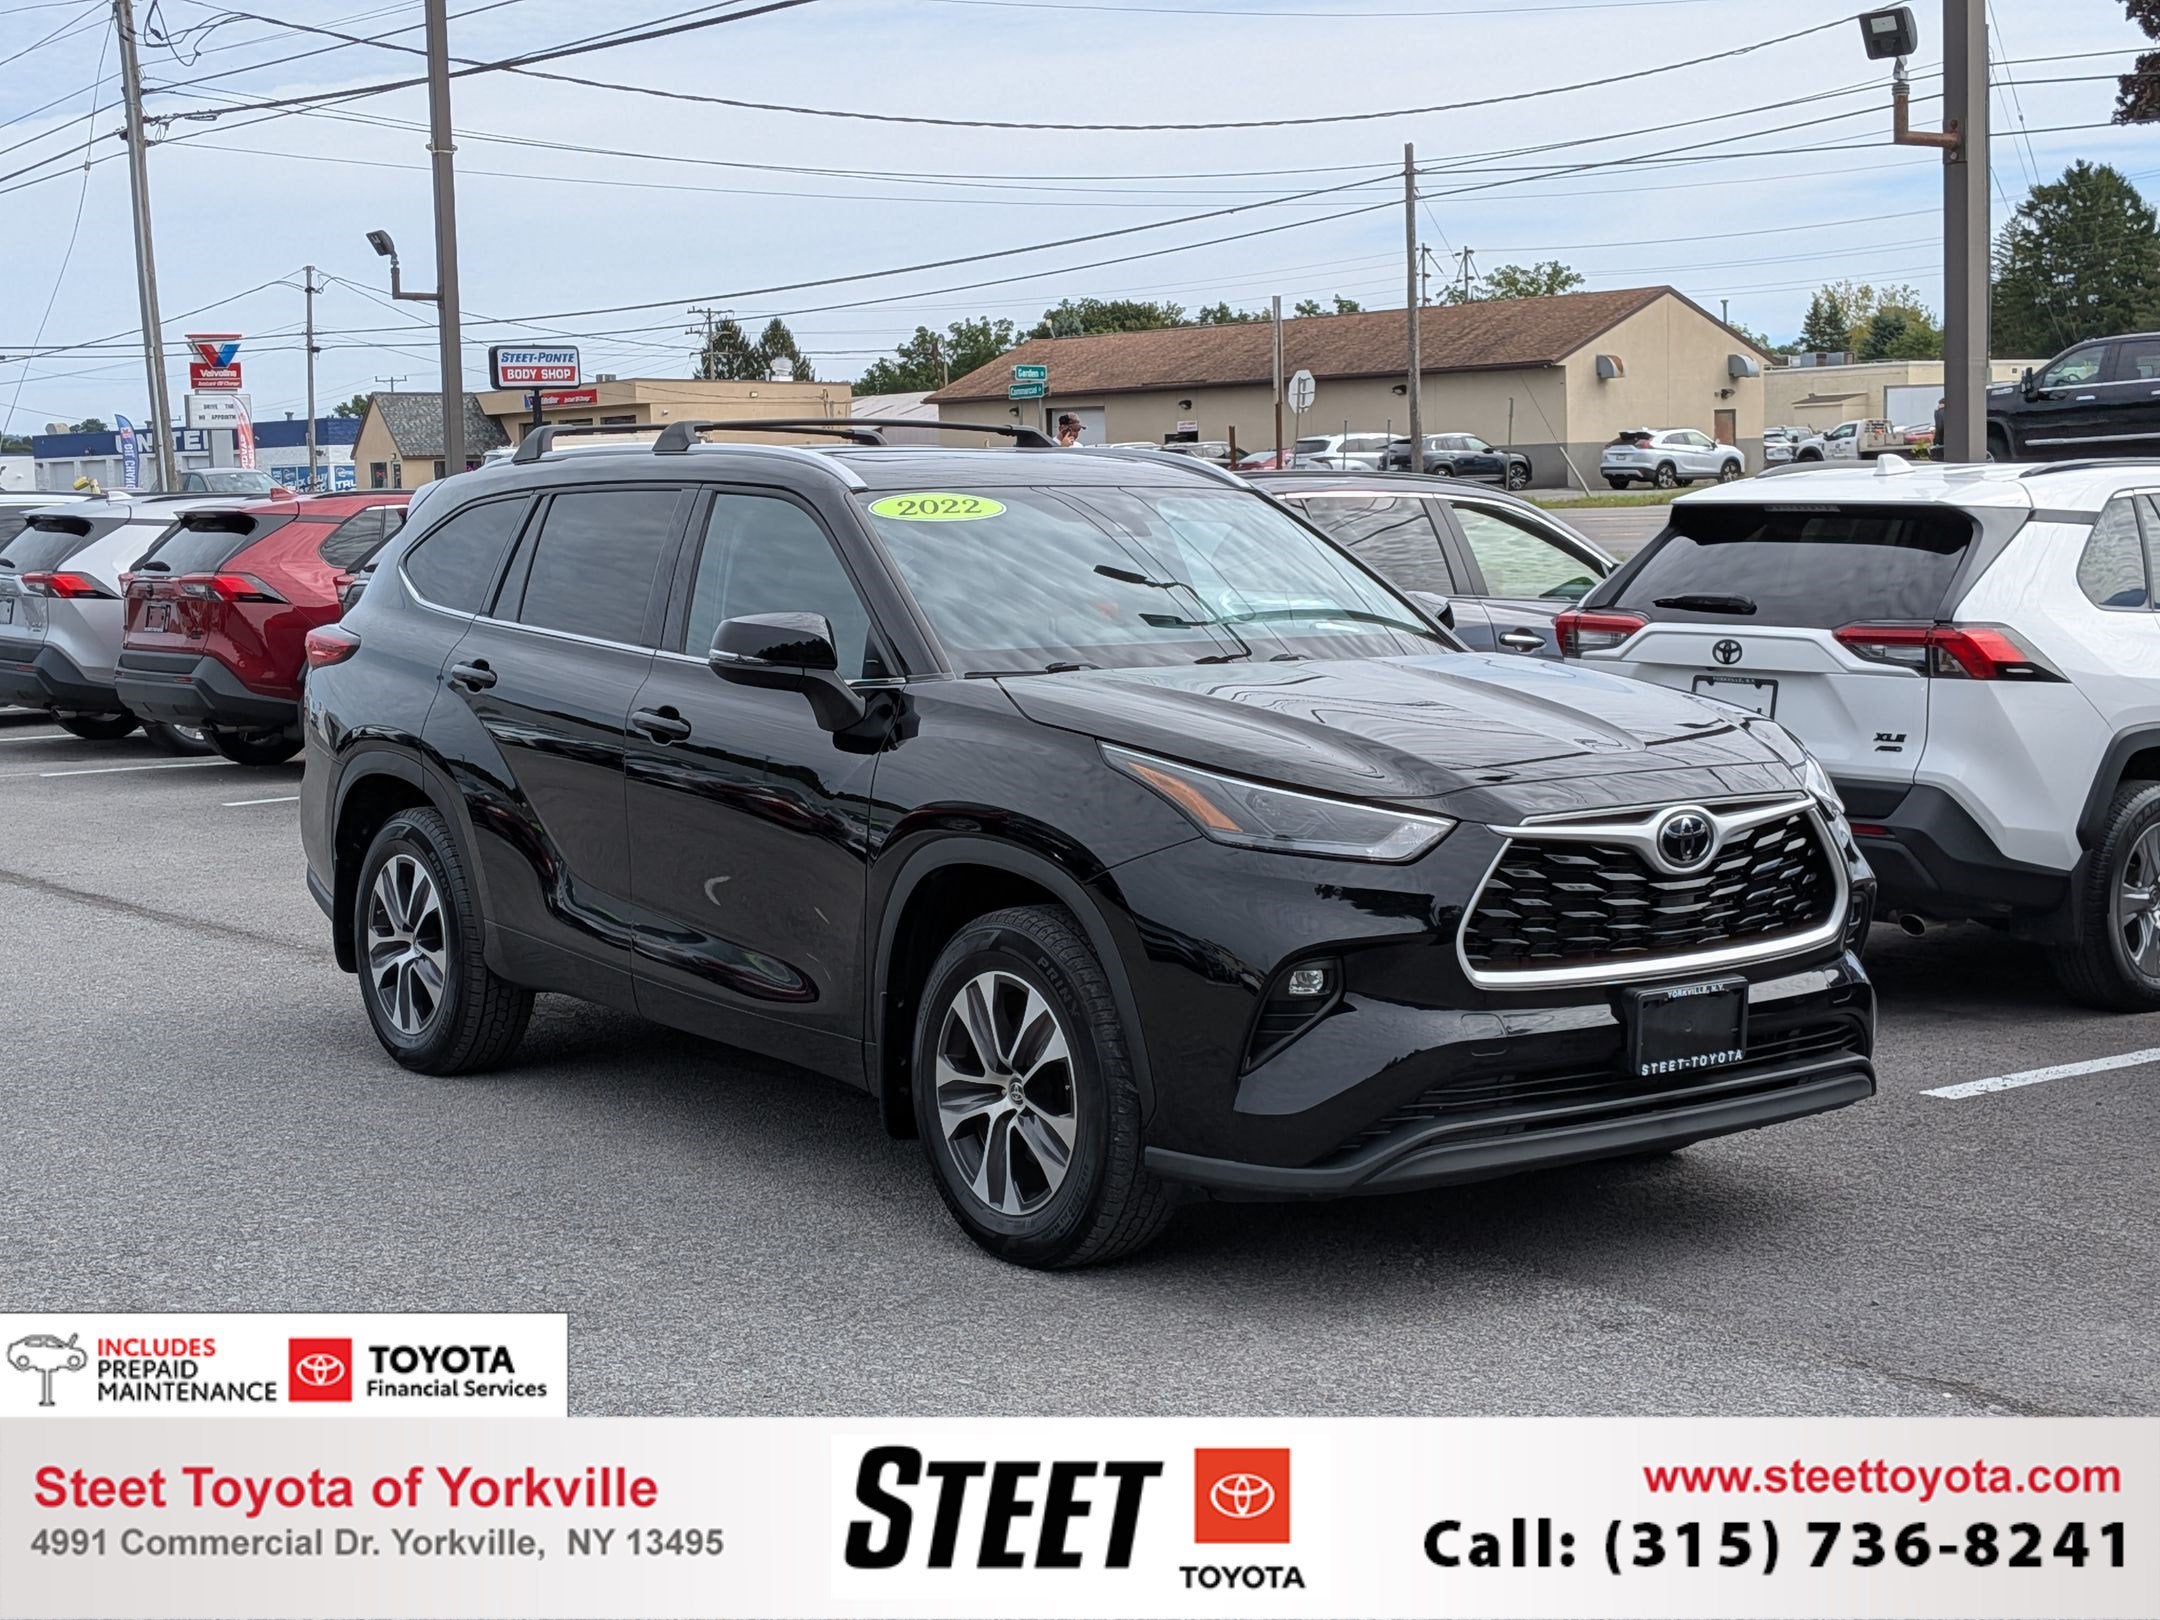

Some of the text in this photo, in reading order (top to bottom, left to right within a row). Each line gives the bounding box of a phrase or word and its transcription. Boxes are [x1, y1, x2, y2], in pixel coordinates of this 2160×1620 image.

[507, 369, 571, 380] BODY SHOP
[897, 499, 982, 516] 2022
